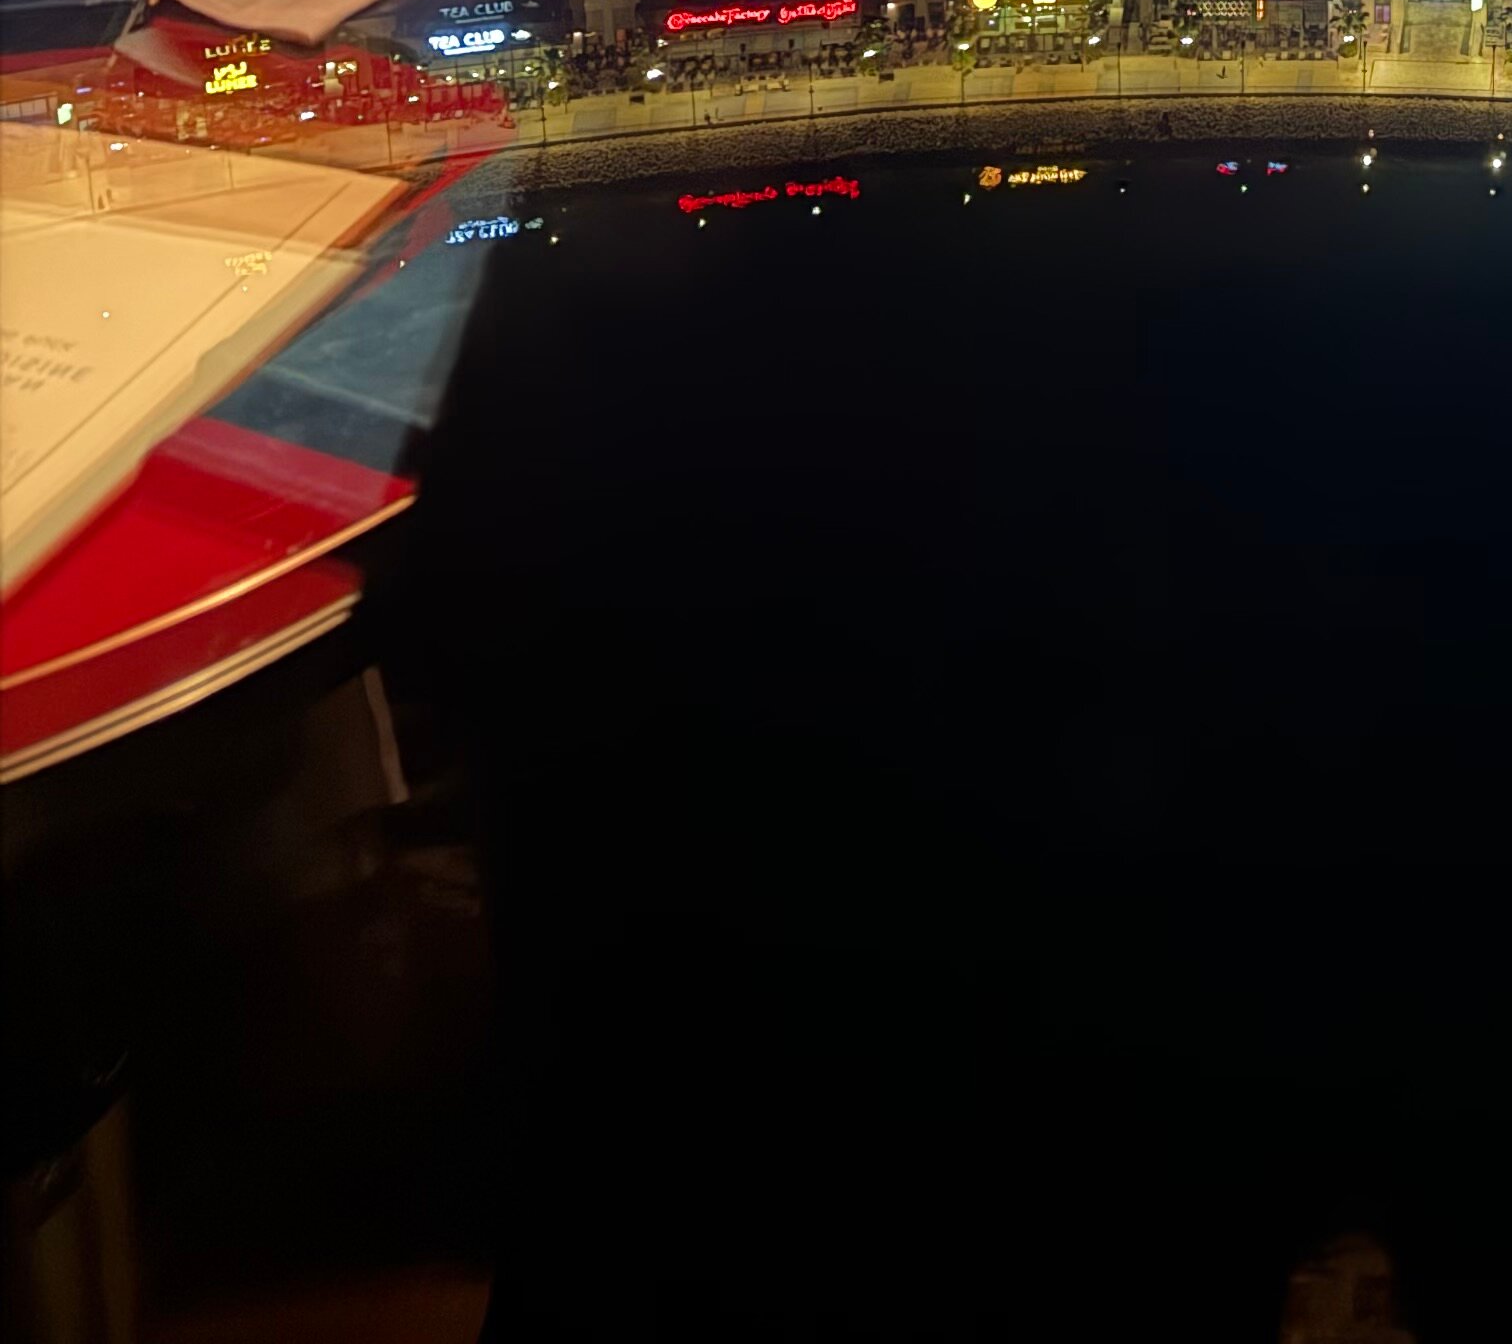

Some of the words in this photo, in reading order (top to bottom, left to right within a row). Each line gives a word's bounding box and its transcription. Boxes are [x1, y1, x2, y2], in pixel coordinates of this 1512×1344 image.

[438, 6, 469, 18] TEA
[473, 0, 514, 15] CLUB
[428, 34, 460, 50] TEA
[463, 29, 505, 46] CLUB
